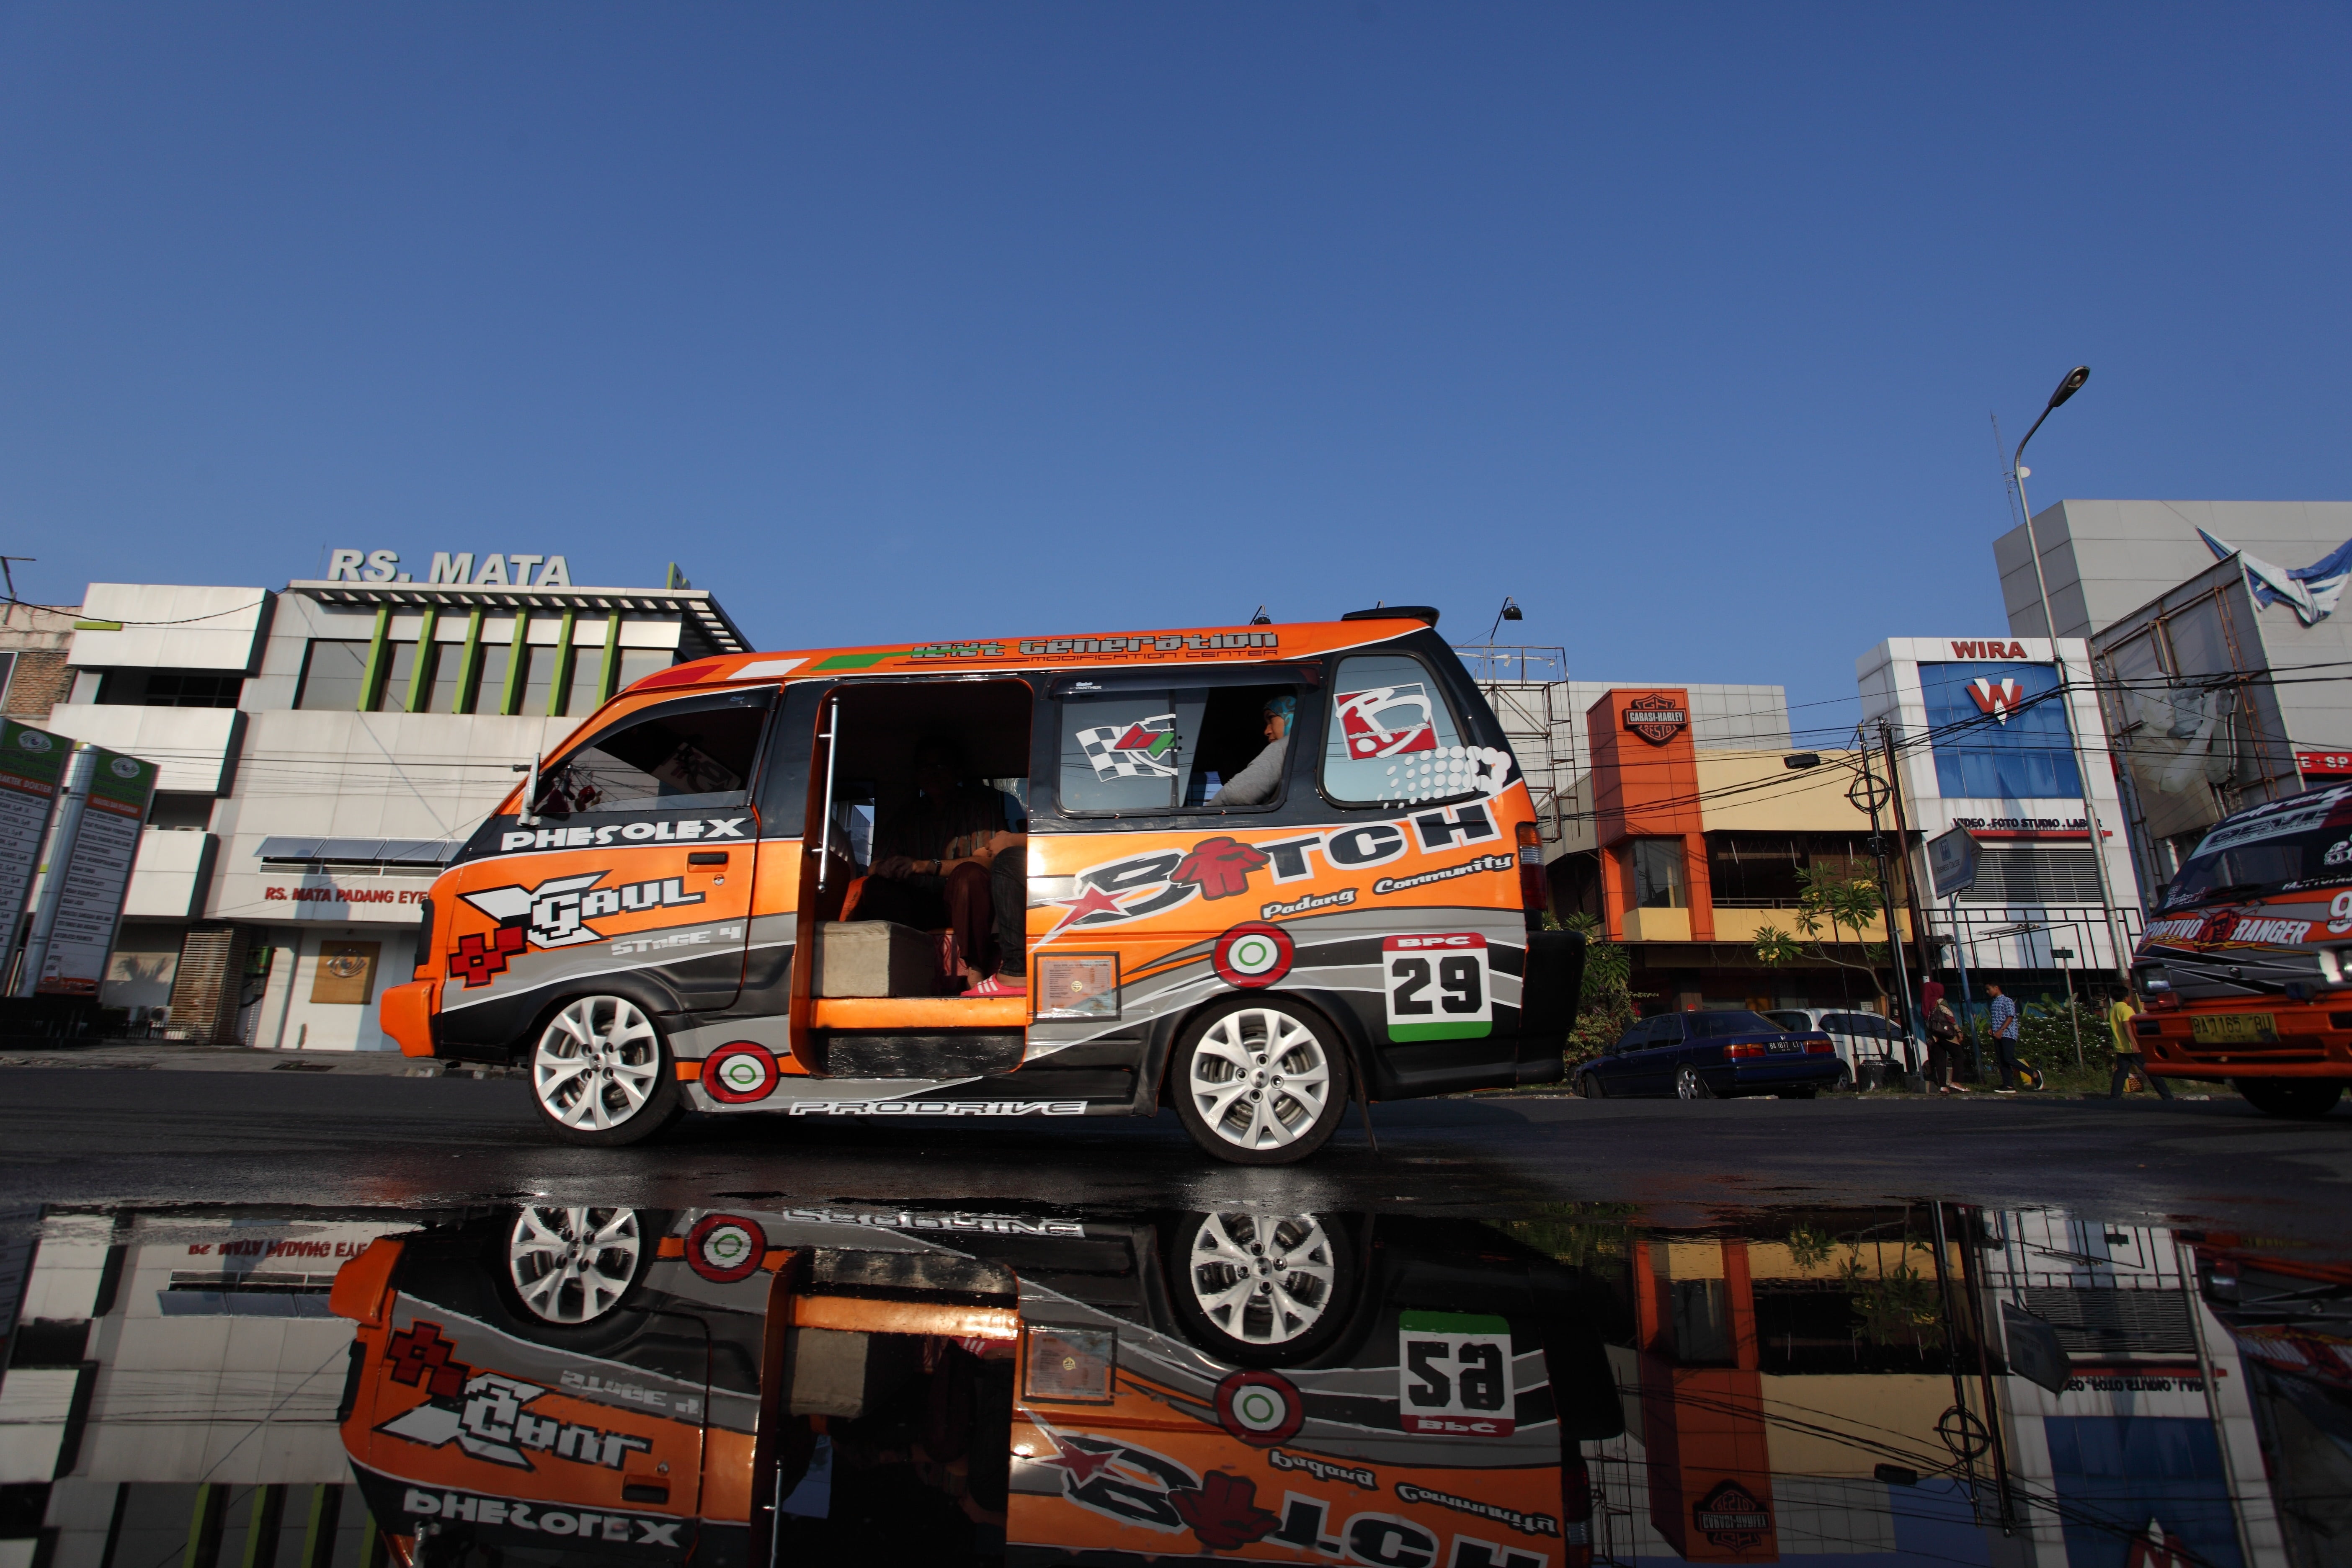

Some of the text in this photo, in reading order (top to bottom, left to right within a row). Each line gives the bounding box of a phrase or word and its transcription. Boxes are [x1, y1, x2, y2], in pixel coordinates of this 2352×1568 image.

[328, 549, 572, 586] RS. MATA
[1031, 650, 1278, 662] MODIFICATION CENTER
[1951, 641, 2027, 658] WIRA
[1643, 698, 1669, 709] GH
[1629, 712, 1683, 722] GARASI-HARLEY
[1644, 725, 1671, 738] RESTO
[23, 779, 53, 794] DOKTER
[1952, 818, 1985, 828] VIDEO
[1991, 818, 2019, 828] FOTO
[2021, 818, 2060, 828] STUDIO
[1374, 855, 1513, 893] Community
[292, 887, 331, 902] MATA
[336, 889, 394, 903] PADANG
[1262, 889, 1356, 919] Padang
[2142, 919, 2312, 944] SPORTIVO RANGER
[1397, 936, 1472, 948] BPC
[1391, 955, 1483, 1016] 29
[2193, 1018, 2208, 1034] BA
[789, 1100, 1088, 1116] PRODRIVE
